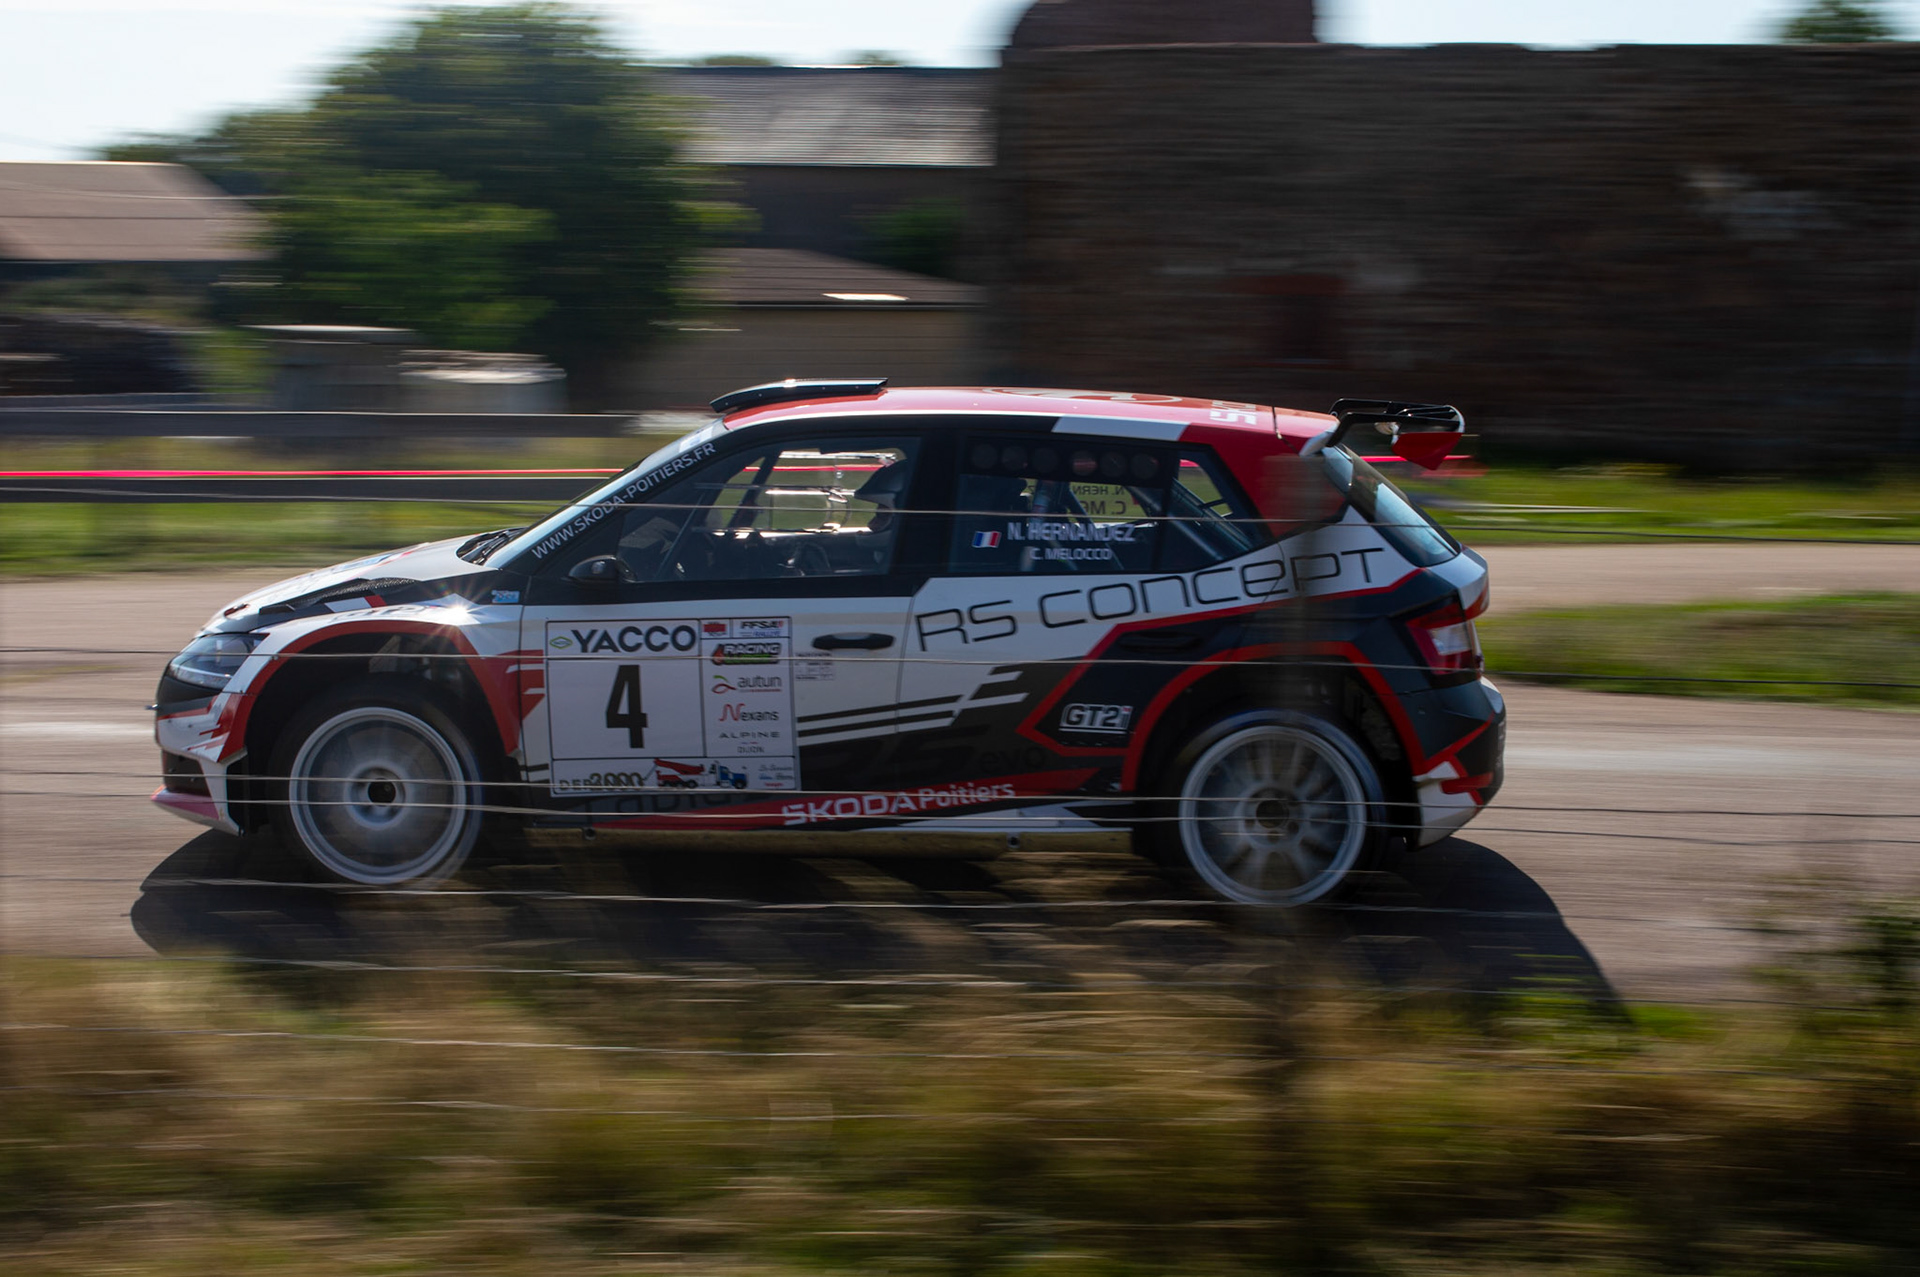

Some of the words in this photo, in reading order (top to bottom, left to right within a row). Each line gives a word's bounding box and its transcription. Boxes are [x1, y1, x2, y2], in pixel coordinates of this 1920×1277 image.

[531, 442, 716, 561] WWW.SKODA-POITIERS.FR
[1027, 522, 1137, 542] HERNANDEZ
[1045, 547, 1113, 561] MELOCCO
[915, 599, 1019, 652] RS
[571, 624, 697, 653] YACCO
[723, 643, 780, 656] RACING
[737, 674, 782, 688] autun
[605, 664, 648, 749] 4
[718, 702, 780, 722] Nexans
[1062, 703, 1132, 730] GT2i
[718, 731, 781, 739] ALPINE
[781, 791, 918, 826] SKODA
[919, 782, 1015, 810] Poitiers
